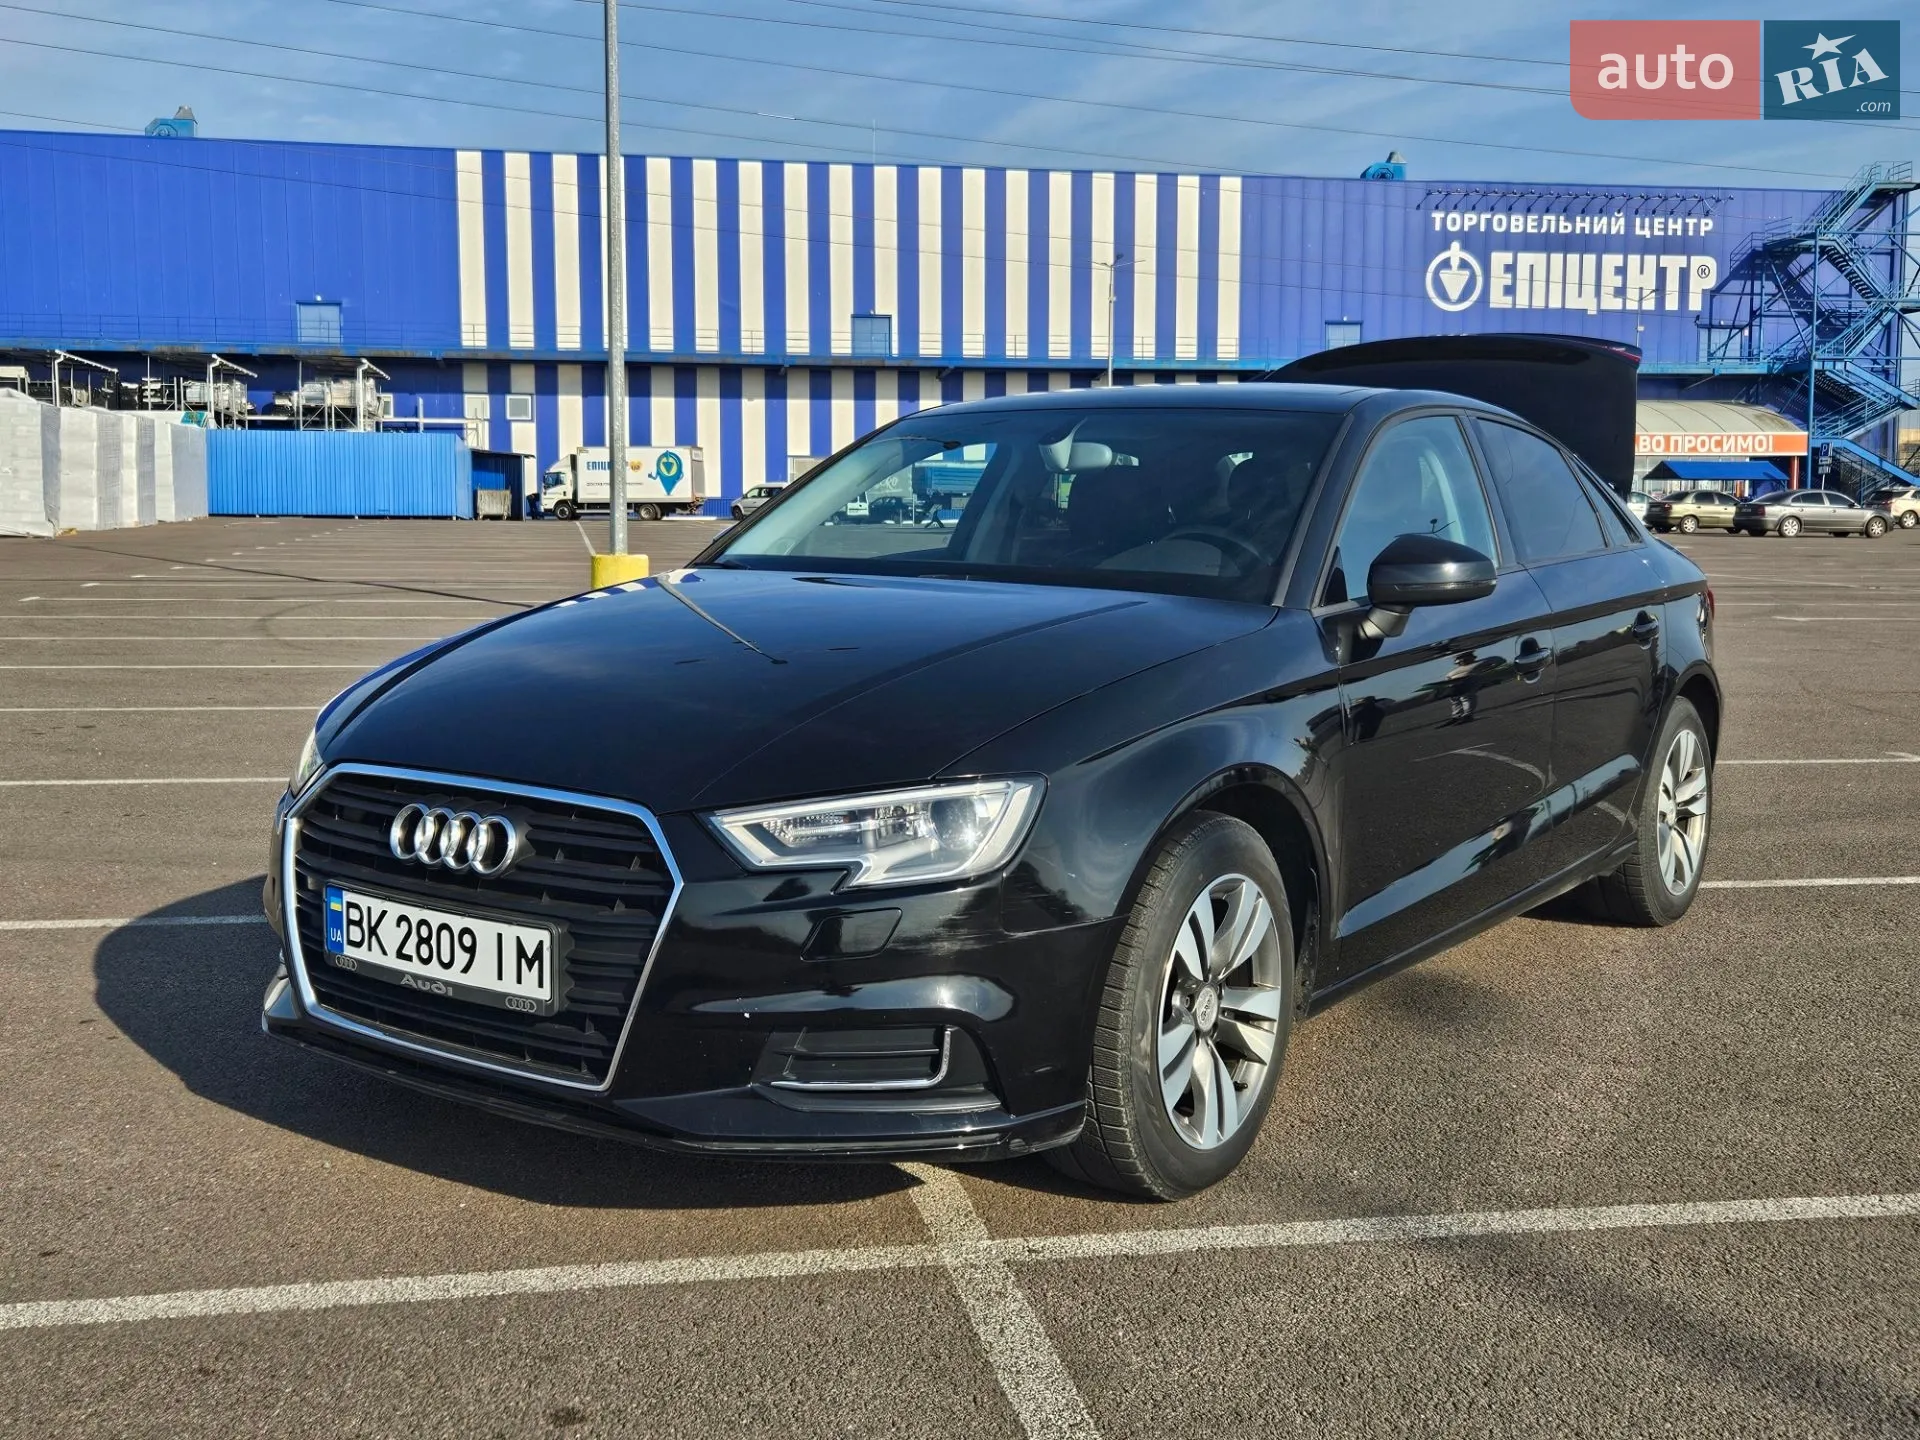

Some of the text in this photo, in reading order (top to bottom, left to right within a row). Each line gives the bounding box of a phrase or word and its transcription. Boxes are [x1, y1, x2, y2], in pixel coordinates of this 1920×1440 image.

[1431, 212, 1714, 238] ТОРГОВЕЛЬНИЙ ЦЕНТР
[1489, 251, 1718, 314] ЕПІЦЕНТР
[1635, 435, 1773, 453] ВО ПРОСИМО!
[330, 927, 342, 943] UA
[345, 901, 544, 989] BK 2809 IM
[400, 973, 453, 997] Audi
